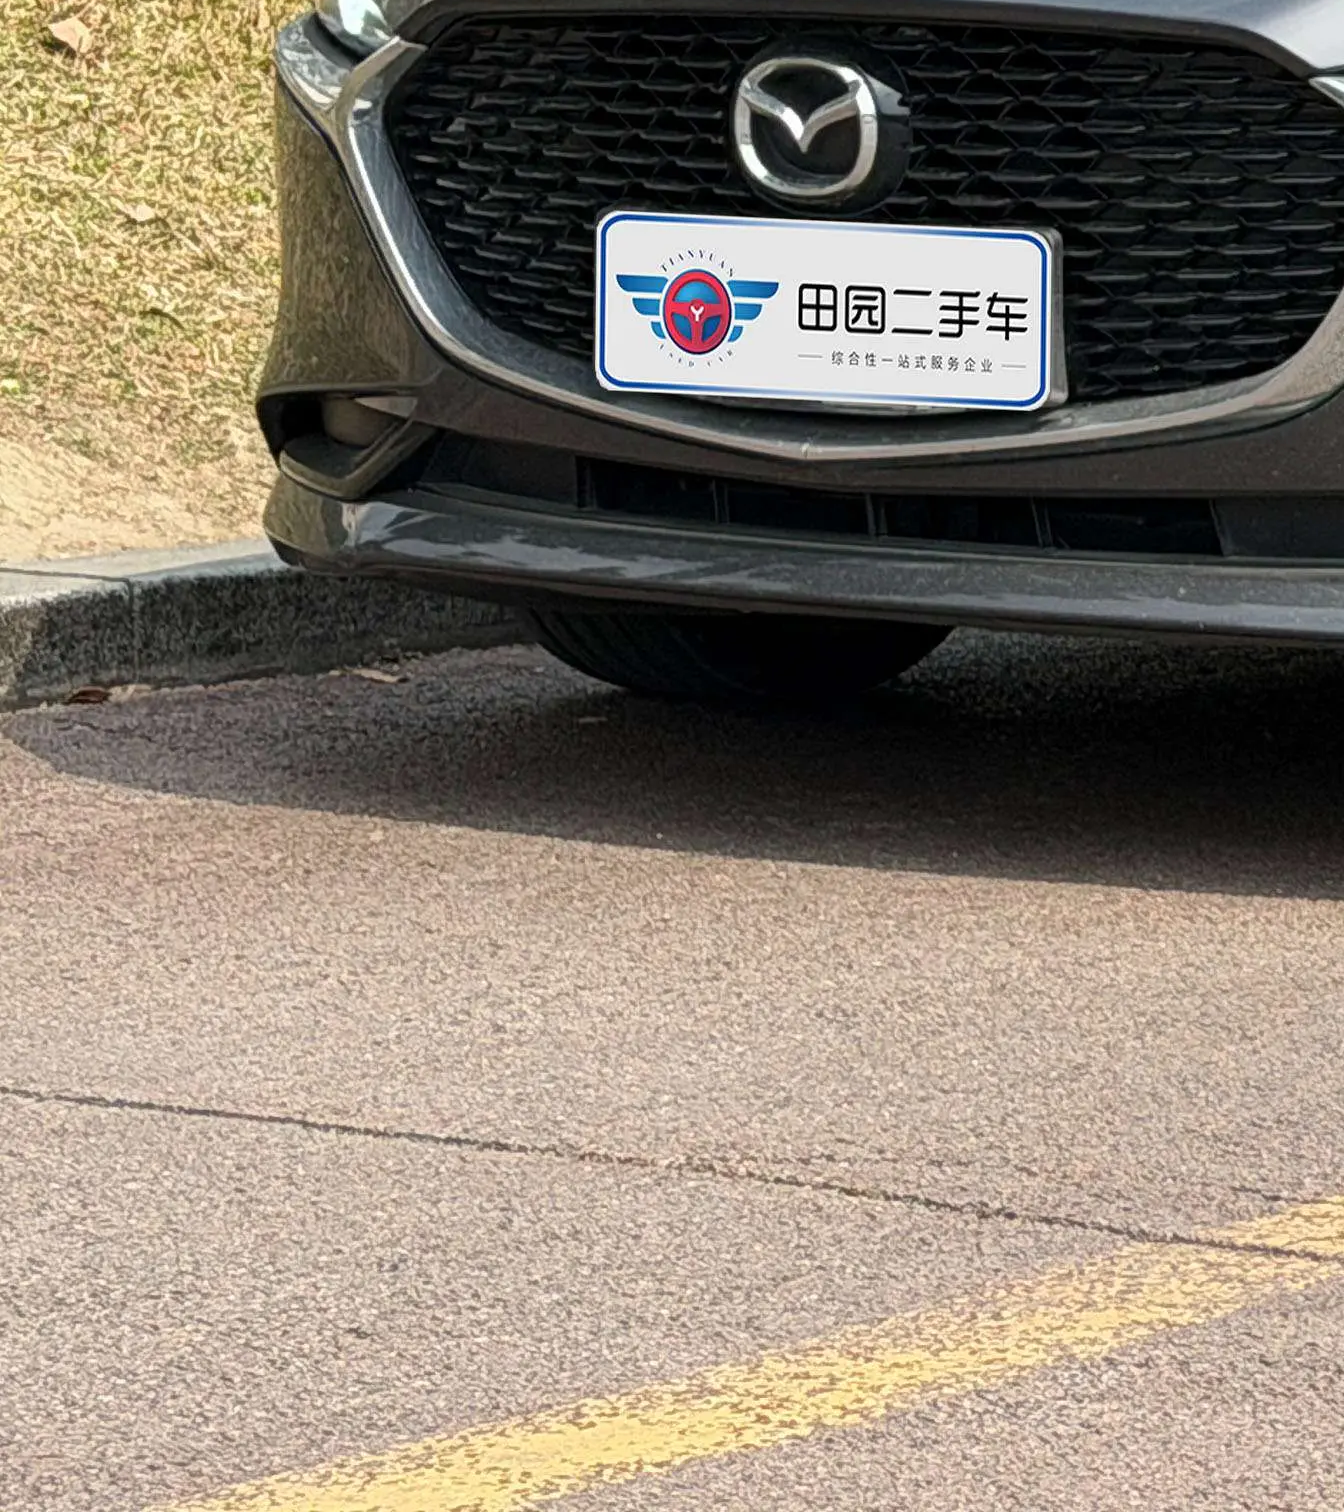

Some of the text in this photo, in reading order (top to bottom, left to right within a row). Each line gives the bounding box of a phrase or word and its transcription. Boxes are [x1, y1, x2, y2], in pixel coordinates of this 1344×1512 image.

[690, 305, 704, 322] Y
[798, 283, 1029, 341] 田园二手车
[831, 350, 993, 373] 综合性一站式服务企业
